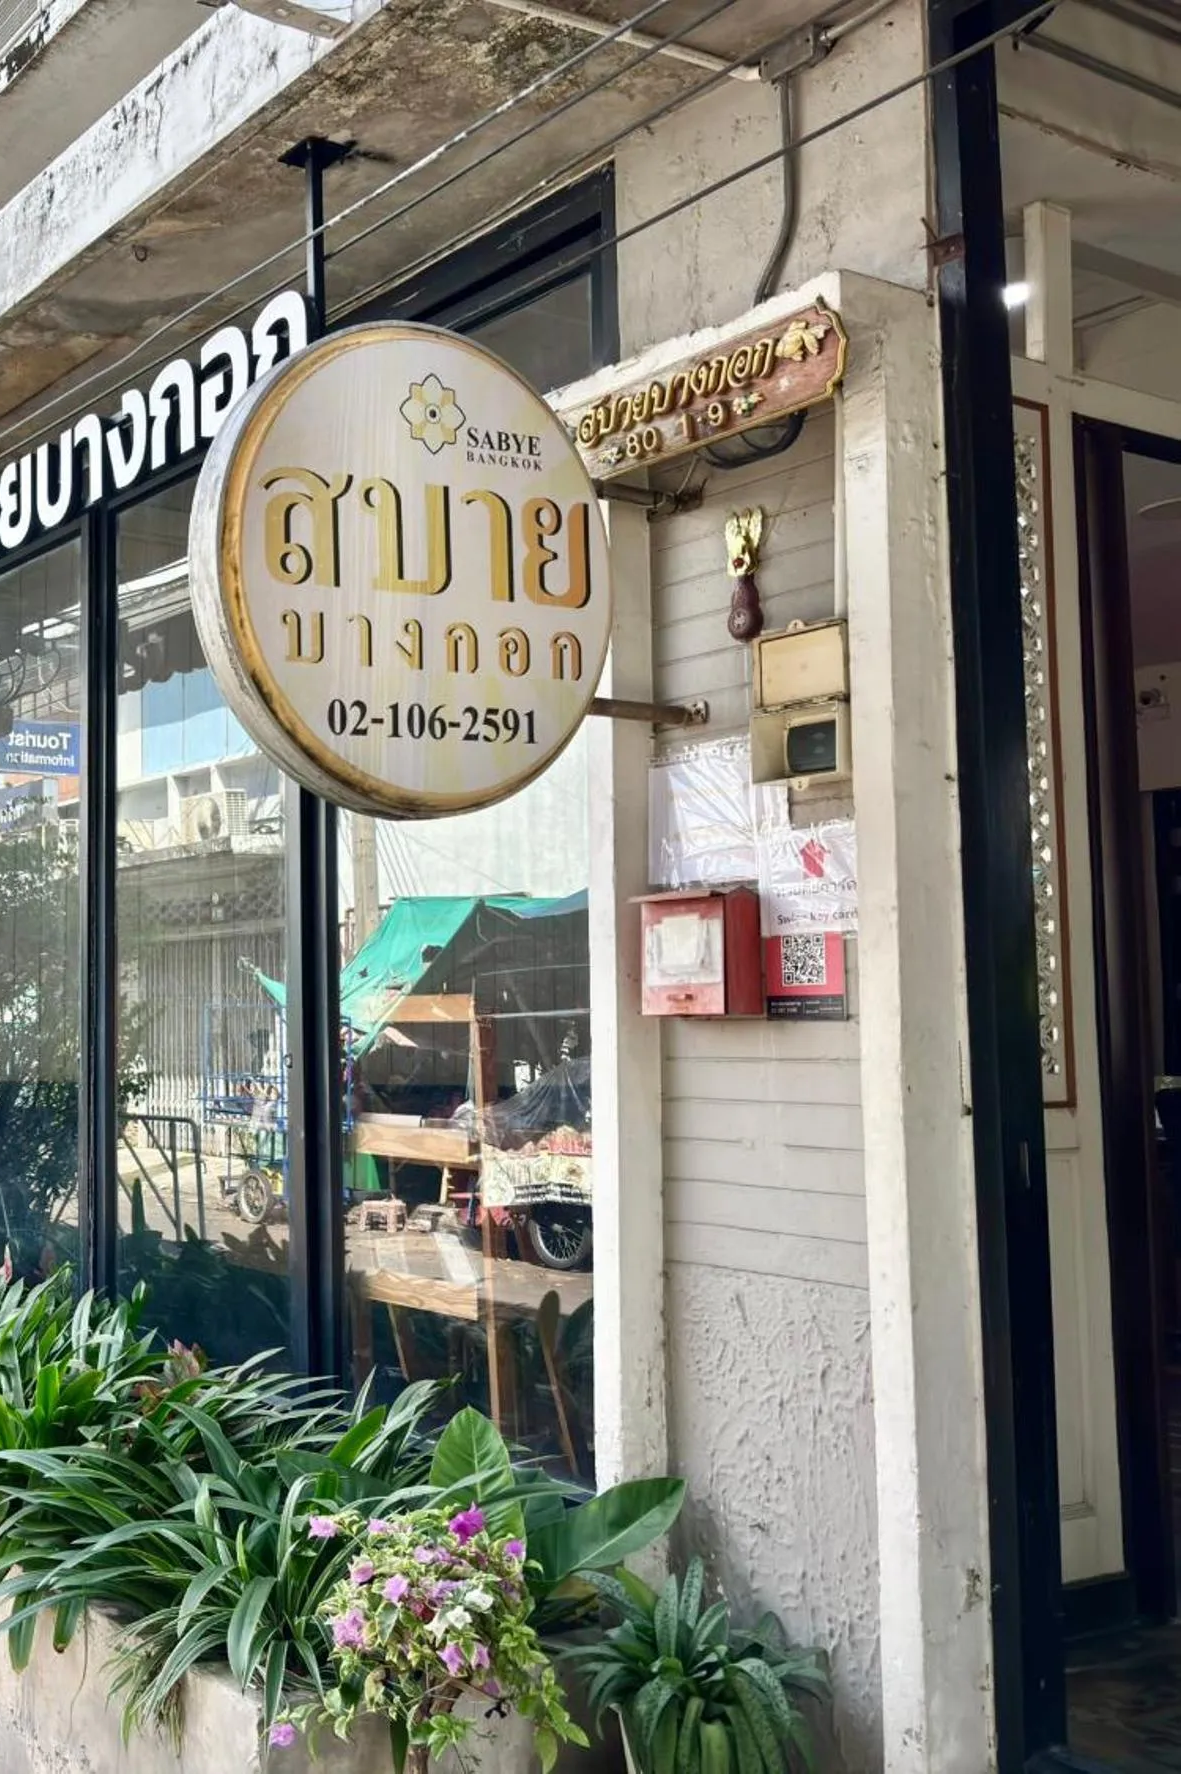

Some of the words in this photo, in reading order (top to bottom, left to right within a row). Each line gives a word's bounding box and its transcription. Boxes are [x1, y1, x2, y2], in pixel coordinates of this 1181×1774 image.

[577, 338, 776, 448] สบายบางกอก
[466, 451, 543, 472] BANGKOK
[467, 427, 542, 457] SABYE
[258, 466, 591, 608] สบาย
[282, 608, 582, 681] บางกอก
[327, 698, 539, 745] 02-106-2591
